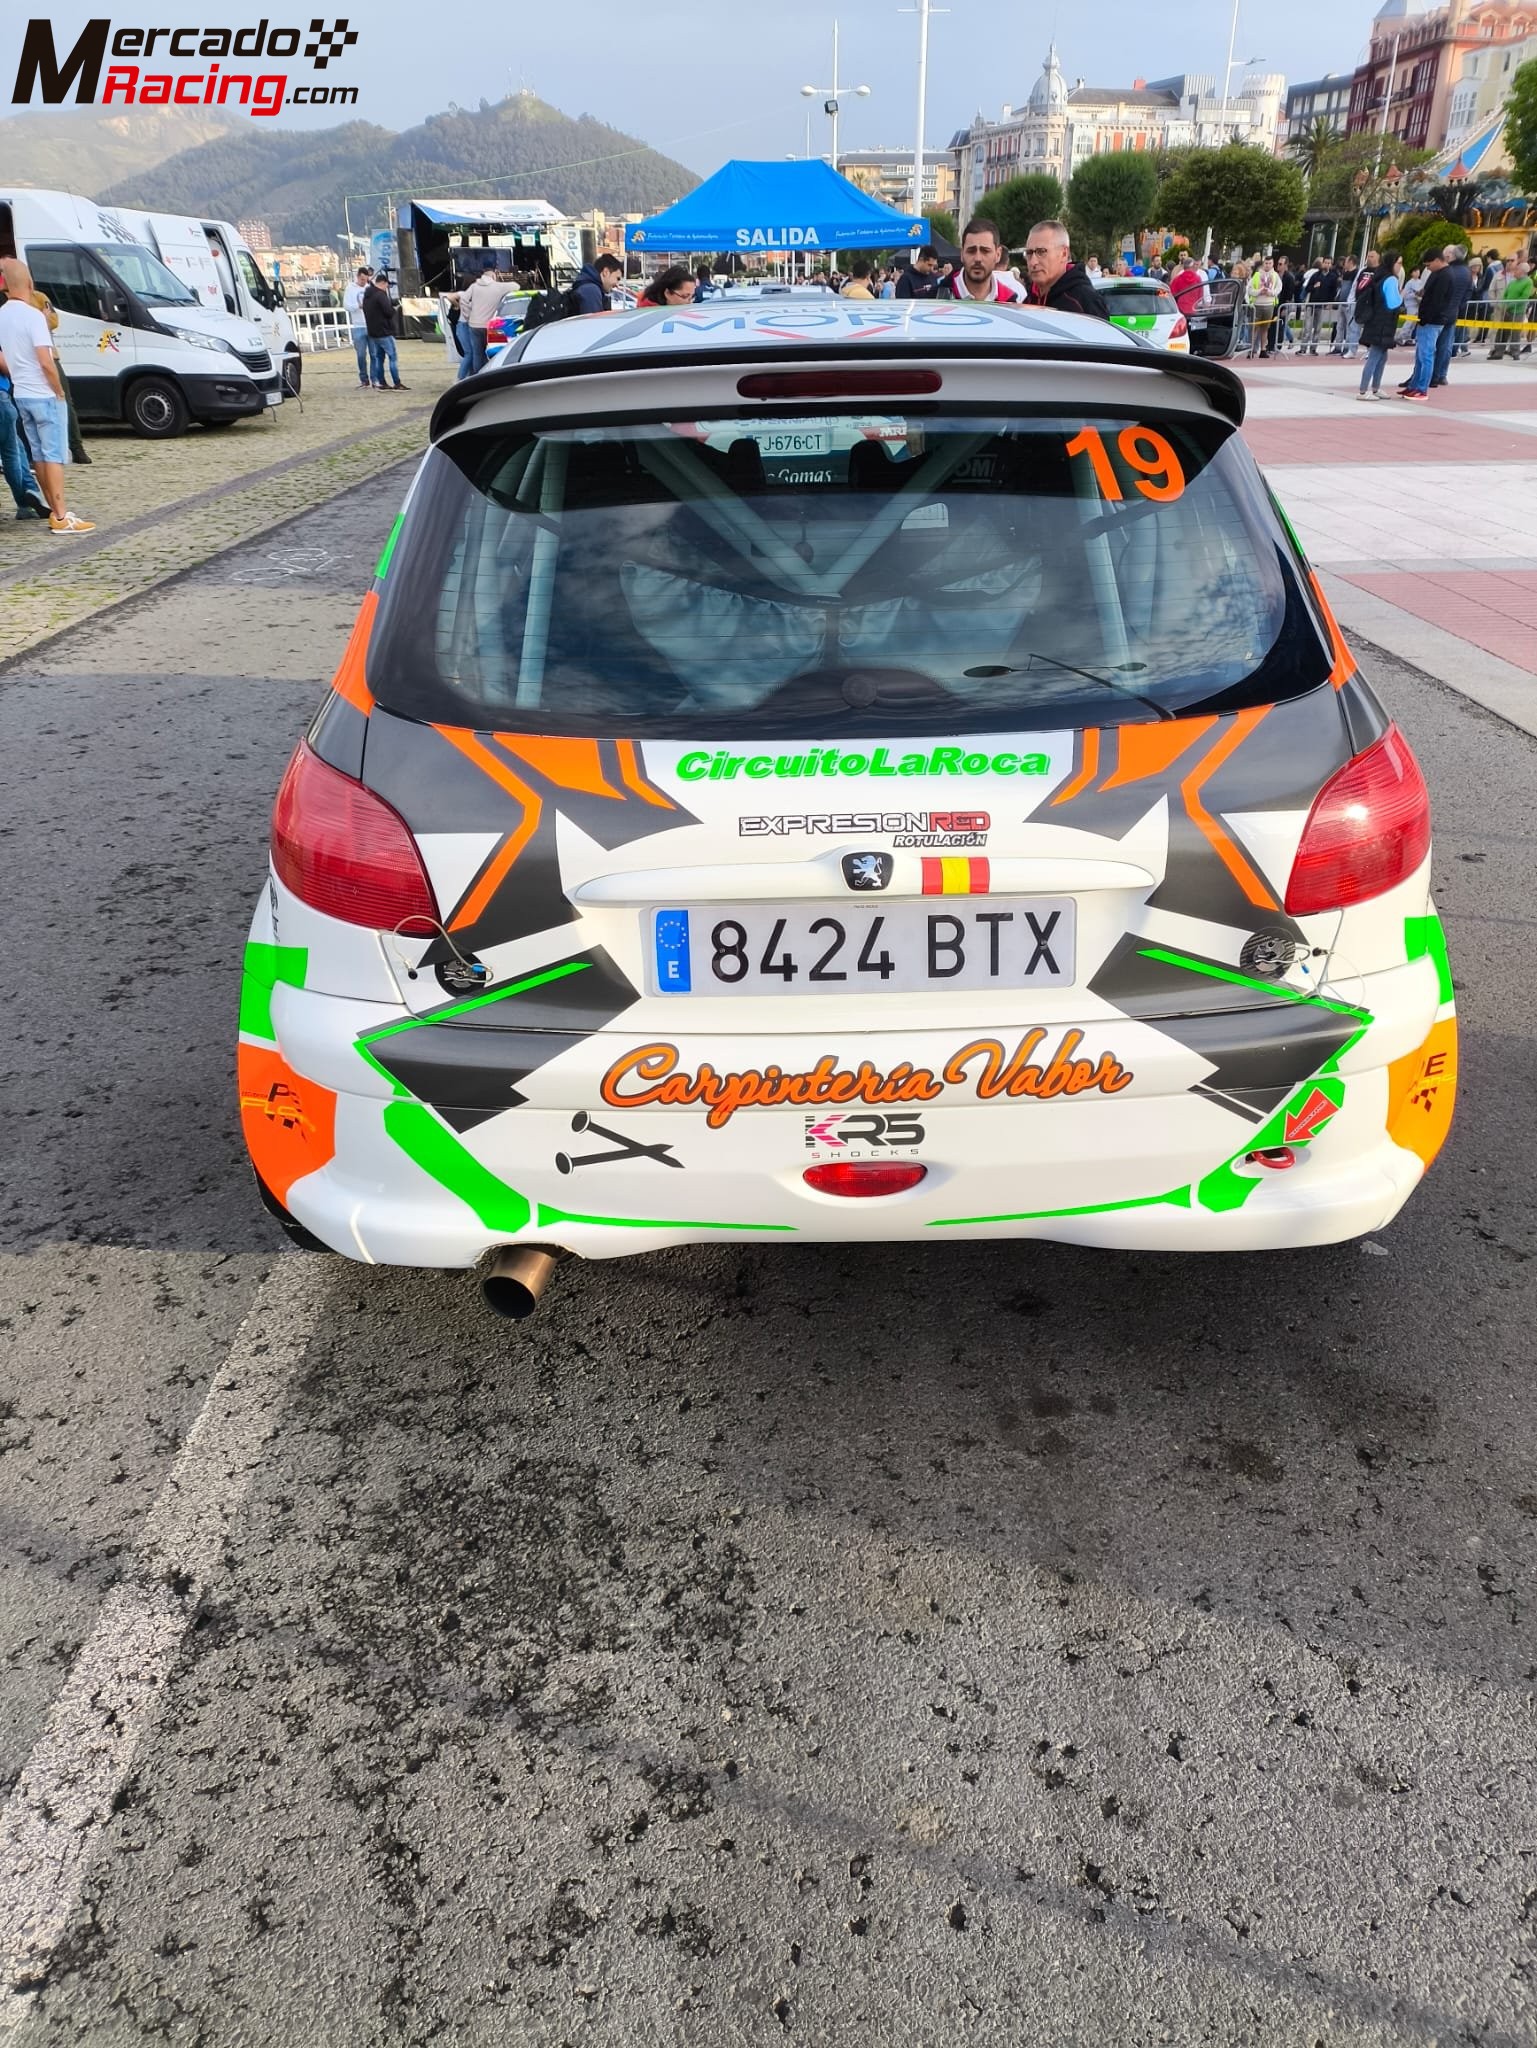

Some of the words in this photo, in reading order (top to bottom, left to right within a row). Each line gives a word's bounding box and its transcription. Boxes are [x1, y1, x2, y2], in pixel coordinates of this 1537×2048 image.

[736, 226, 820, 246] SALIDA
[661, 313, 993, 334] MORO
[1065, 425, 1185, 503] 19
[676, 746, 1051, 780] CircuitoLaRoca
[893, 832, 988, 848] ROTULACIÓN
[710, 916, 896, 984] 8424
[927, 911, 1062, 979] BTX
[667, 960, 680, 979] E
[600, 1042, 946, 1129] Carpintería
[945, 1027, 1135, 1100] Vabor
[811, 1148, 920, 1159] SHOCKS
